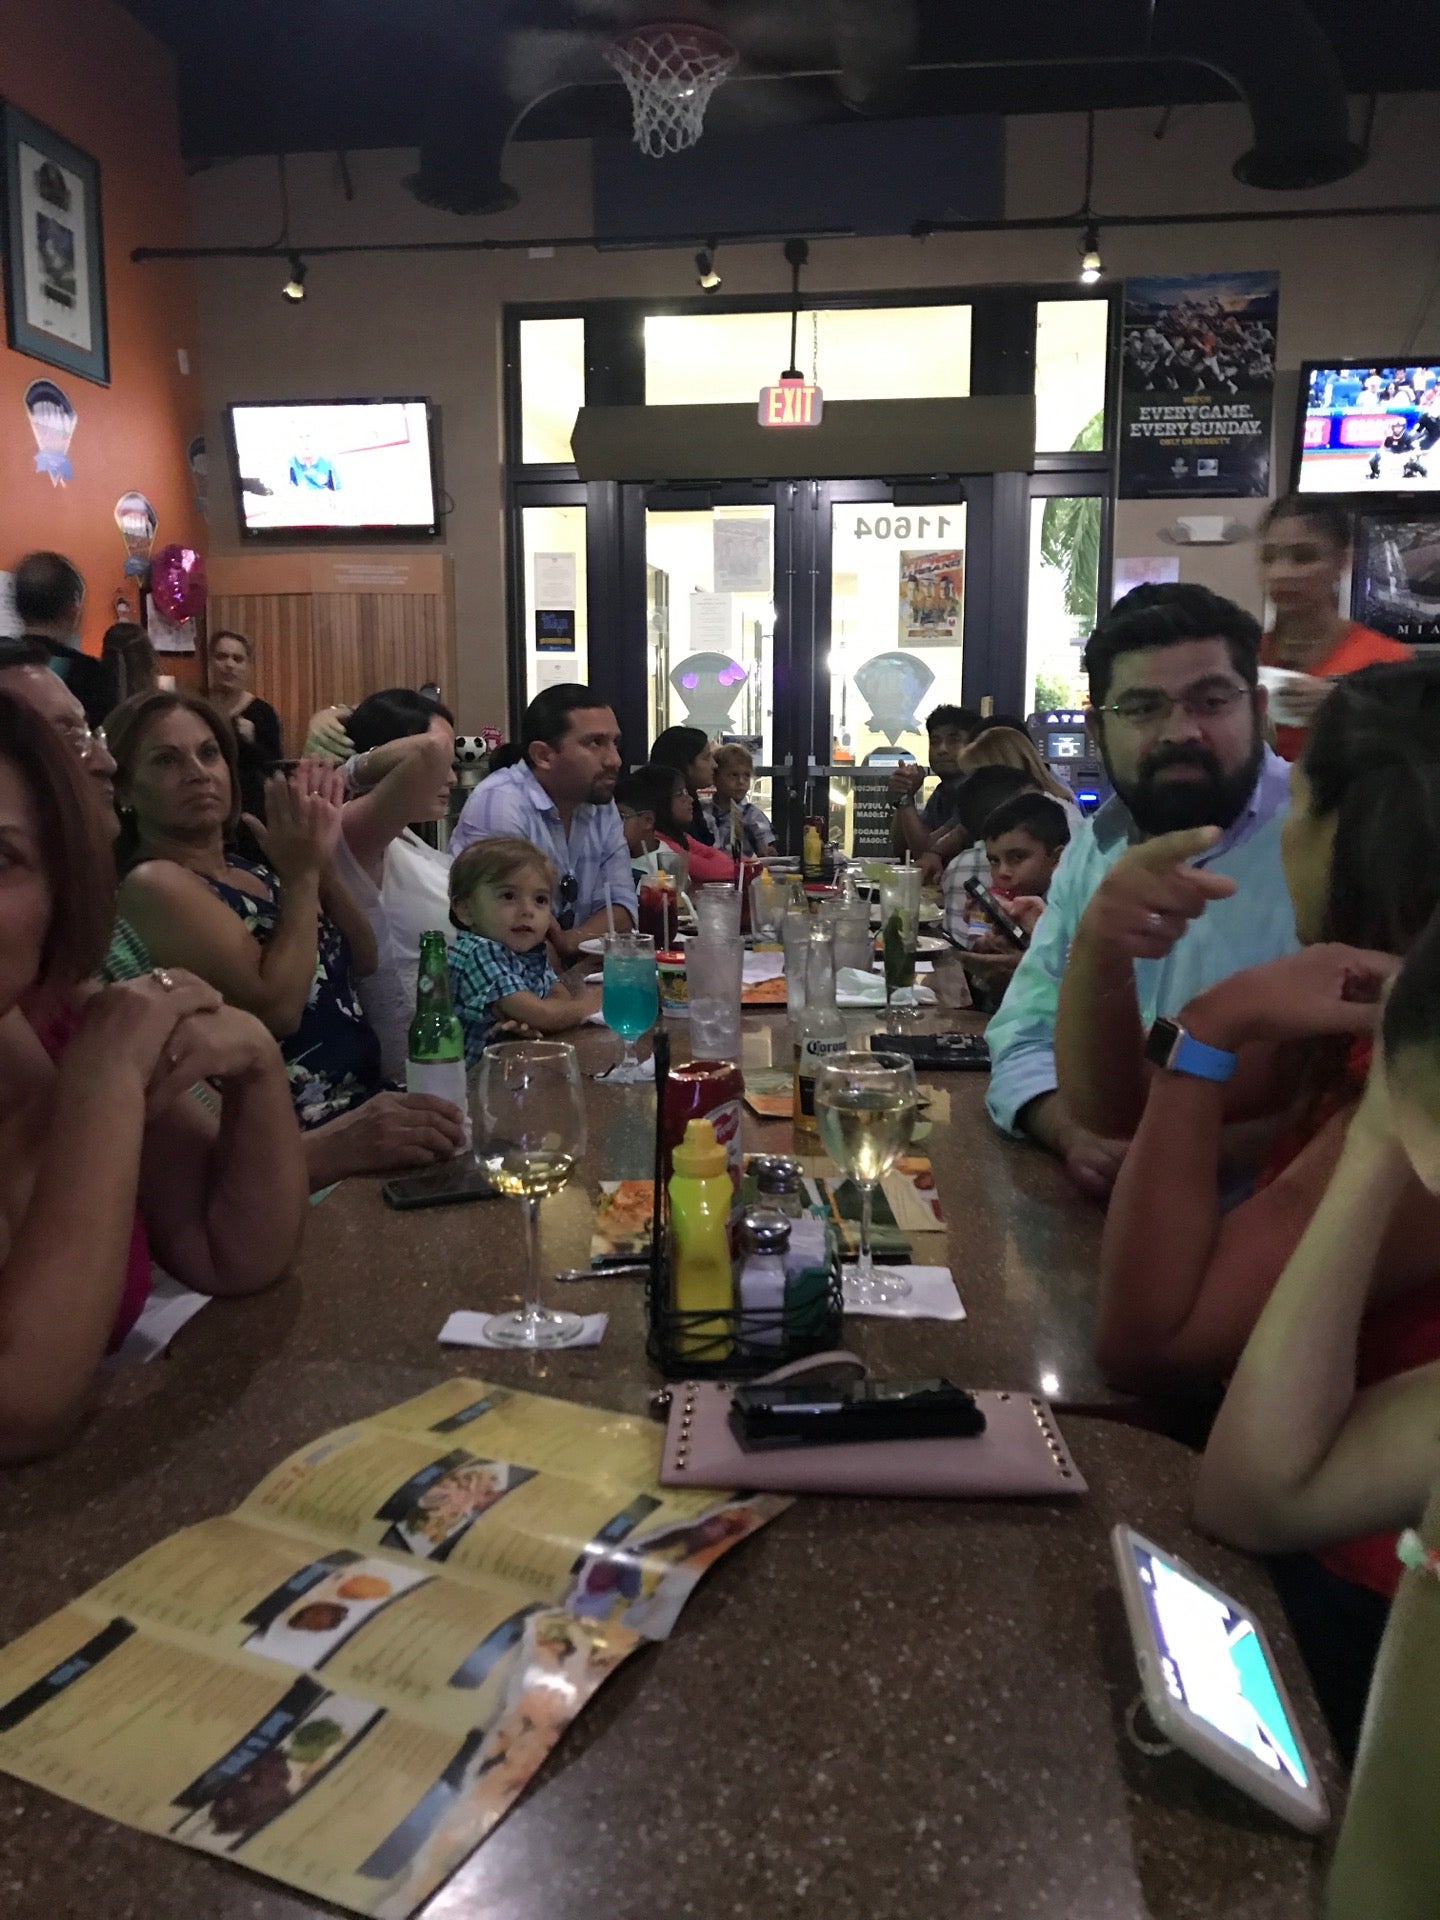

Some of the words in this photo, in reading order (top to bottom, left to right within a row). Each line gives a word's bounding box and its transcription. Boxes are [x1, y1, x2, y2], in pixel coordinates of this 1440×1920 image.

[767, 387, 816, 424] EXIT
[1139, 406, 1198, 421] EVERY
[1199, 404, 1254, 420] GAME.
[1130, 422, 1190, 437] EVERY
[1190, 420, 1263, 436] SUNDAY.
[1047, 714, 1086, 724] ATM
